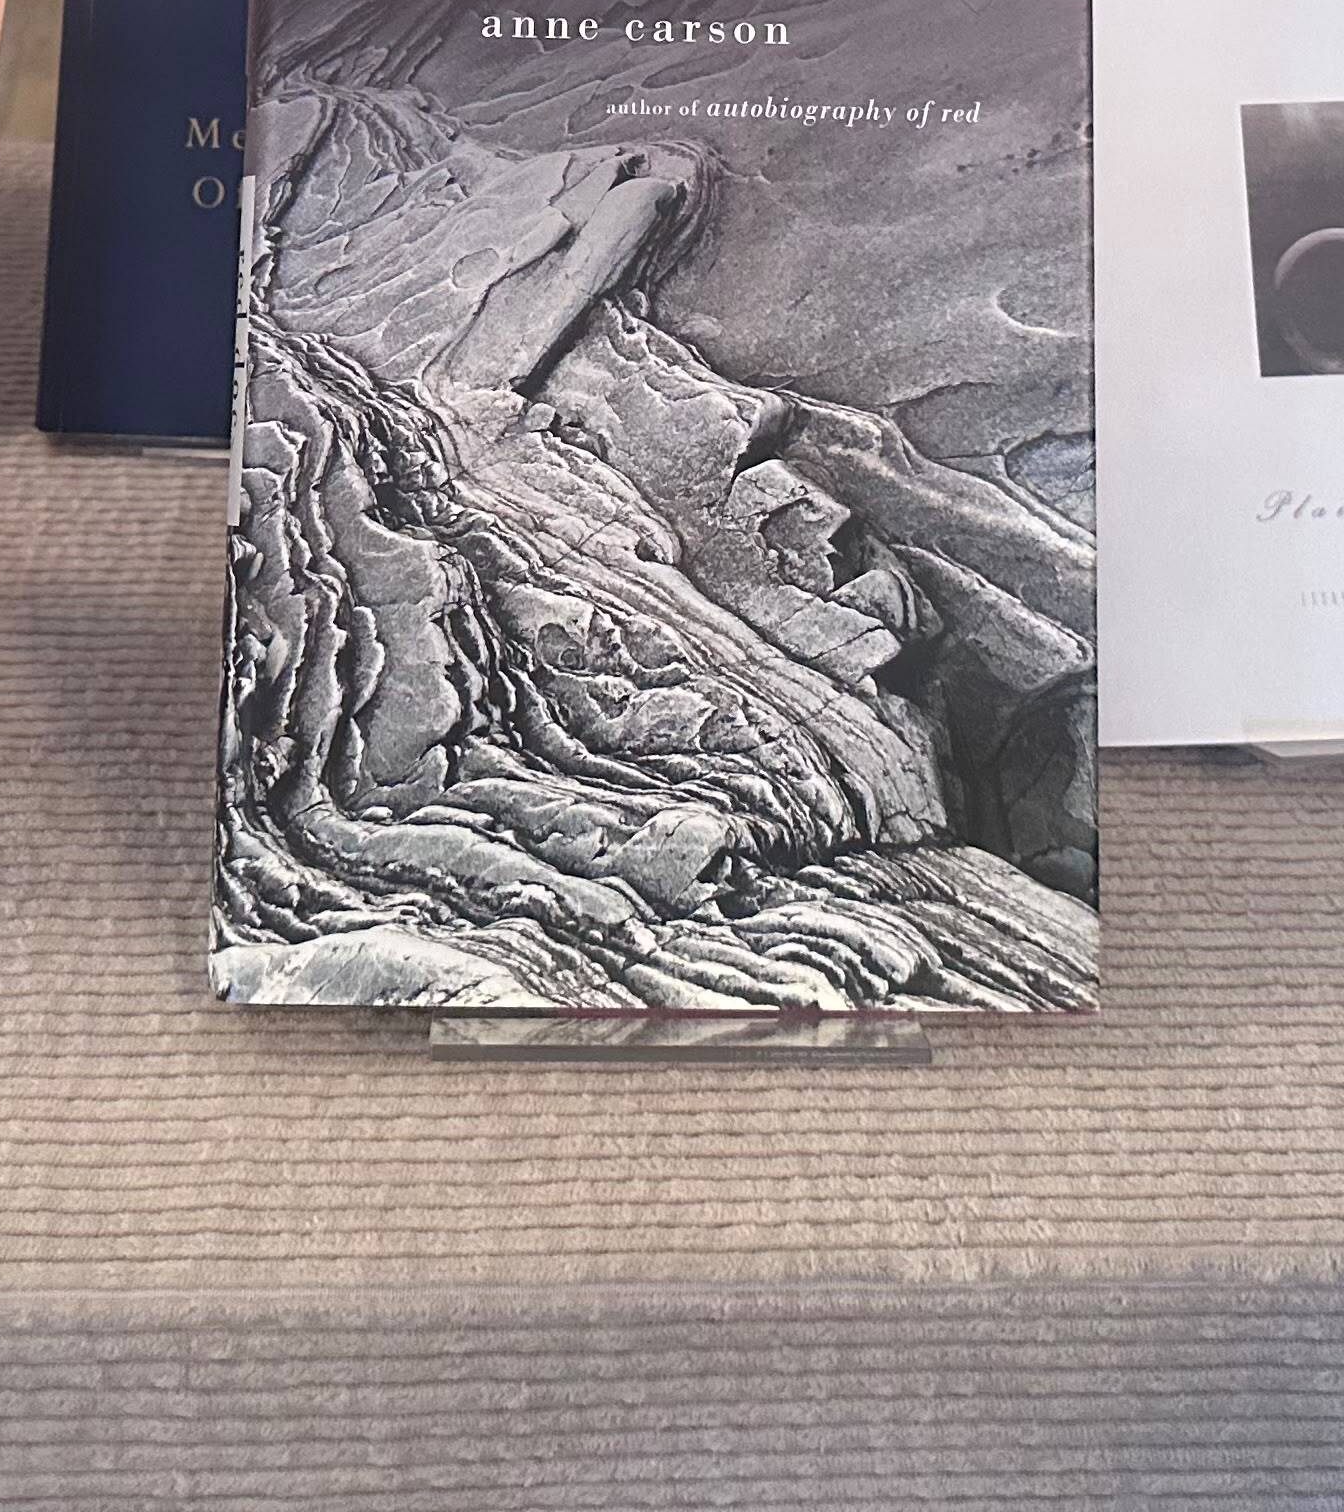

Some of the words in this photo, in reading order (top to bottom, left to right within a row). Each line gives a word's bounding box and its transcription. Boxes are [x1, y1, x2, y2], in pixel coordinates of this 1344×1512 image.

[481, 13, 600, 41] anne
[625, 16, 791, 46] carson
[605, 97, 672, 117] author
[679, 98, 706, 117] of
[706, 98, 897, 128] autobiography
[906, 100, 930, 129] of
[941, 101, 982, 124] red
